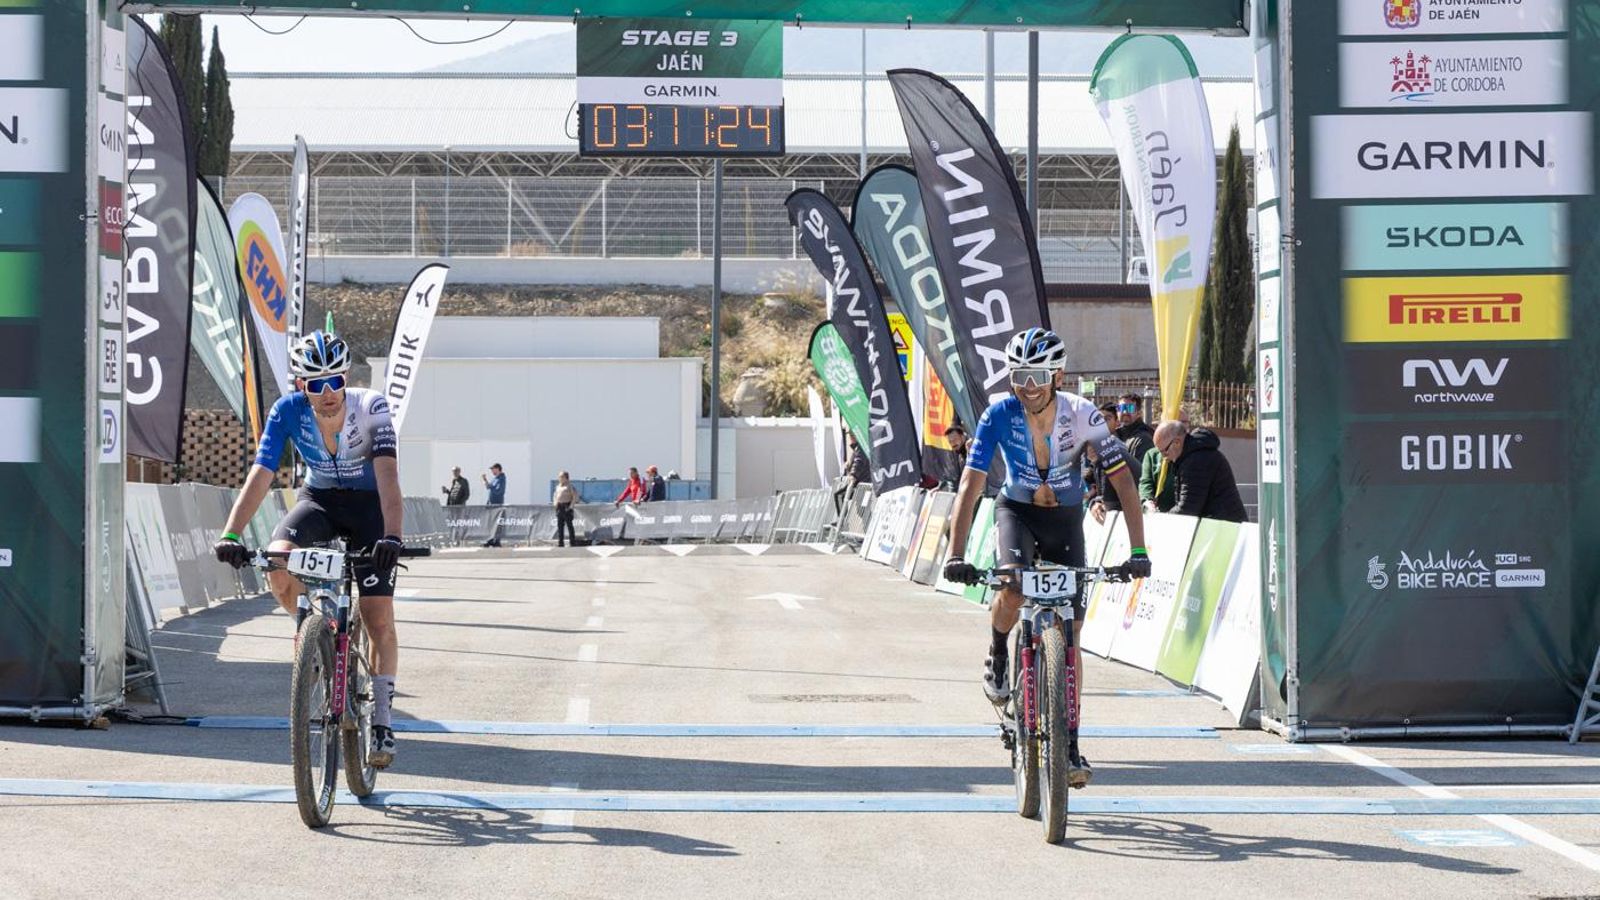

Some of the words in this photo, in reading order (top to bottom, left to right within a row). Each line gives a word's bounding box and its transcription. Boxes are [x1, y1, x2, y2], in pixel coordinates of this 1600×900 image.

[1429, 10, 1445, 20] DE
[1448, 7, 1480, 20] JAÉN
[621, 30, 710, 46] STAGE
[720, 31, 738, 46] 3
[656, 51, 703, 71] JAÉN
[1434, 56, 1523, 73] AYUNTAMIENTO
[643, 85, 718, 97] GARMIN
[1434, 78, 1448, 92] DE
[1451, 77, 1506, 92] CORDOBA
[594, 105, 770, 147] 03:11:24
[1357, 140, 1545, 170] GARMIN
[1389, 293, 1523, 324] PIRELLI
[1415, 392, 1494, 402] northwave
[1401, 434, 1512, 470] GOBIK
[300, 551, 334, 574] 15-1
[1397, 550, 1490, 571] Andalucía
[1032, 573, 1068, 594] 15-2
[1398, 573, 1438, 589] BIKE
[1441, 572, 1491, 589] RACE
[1500, 574, 1541, 583] GARMIN
